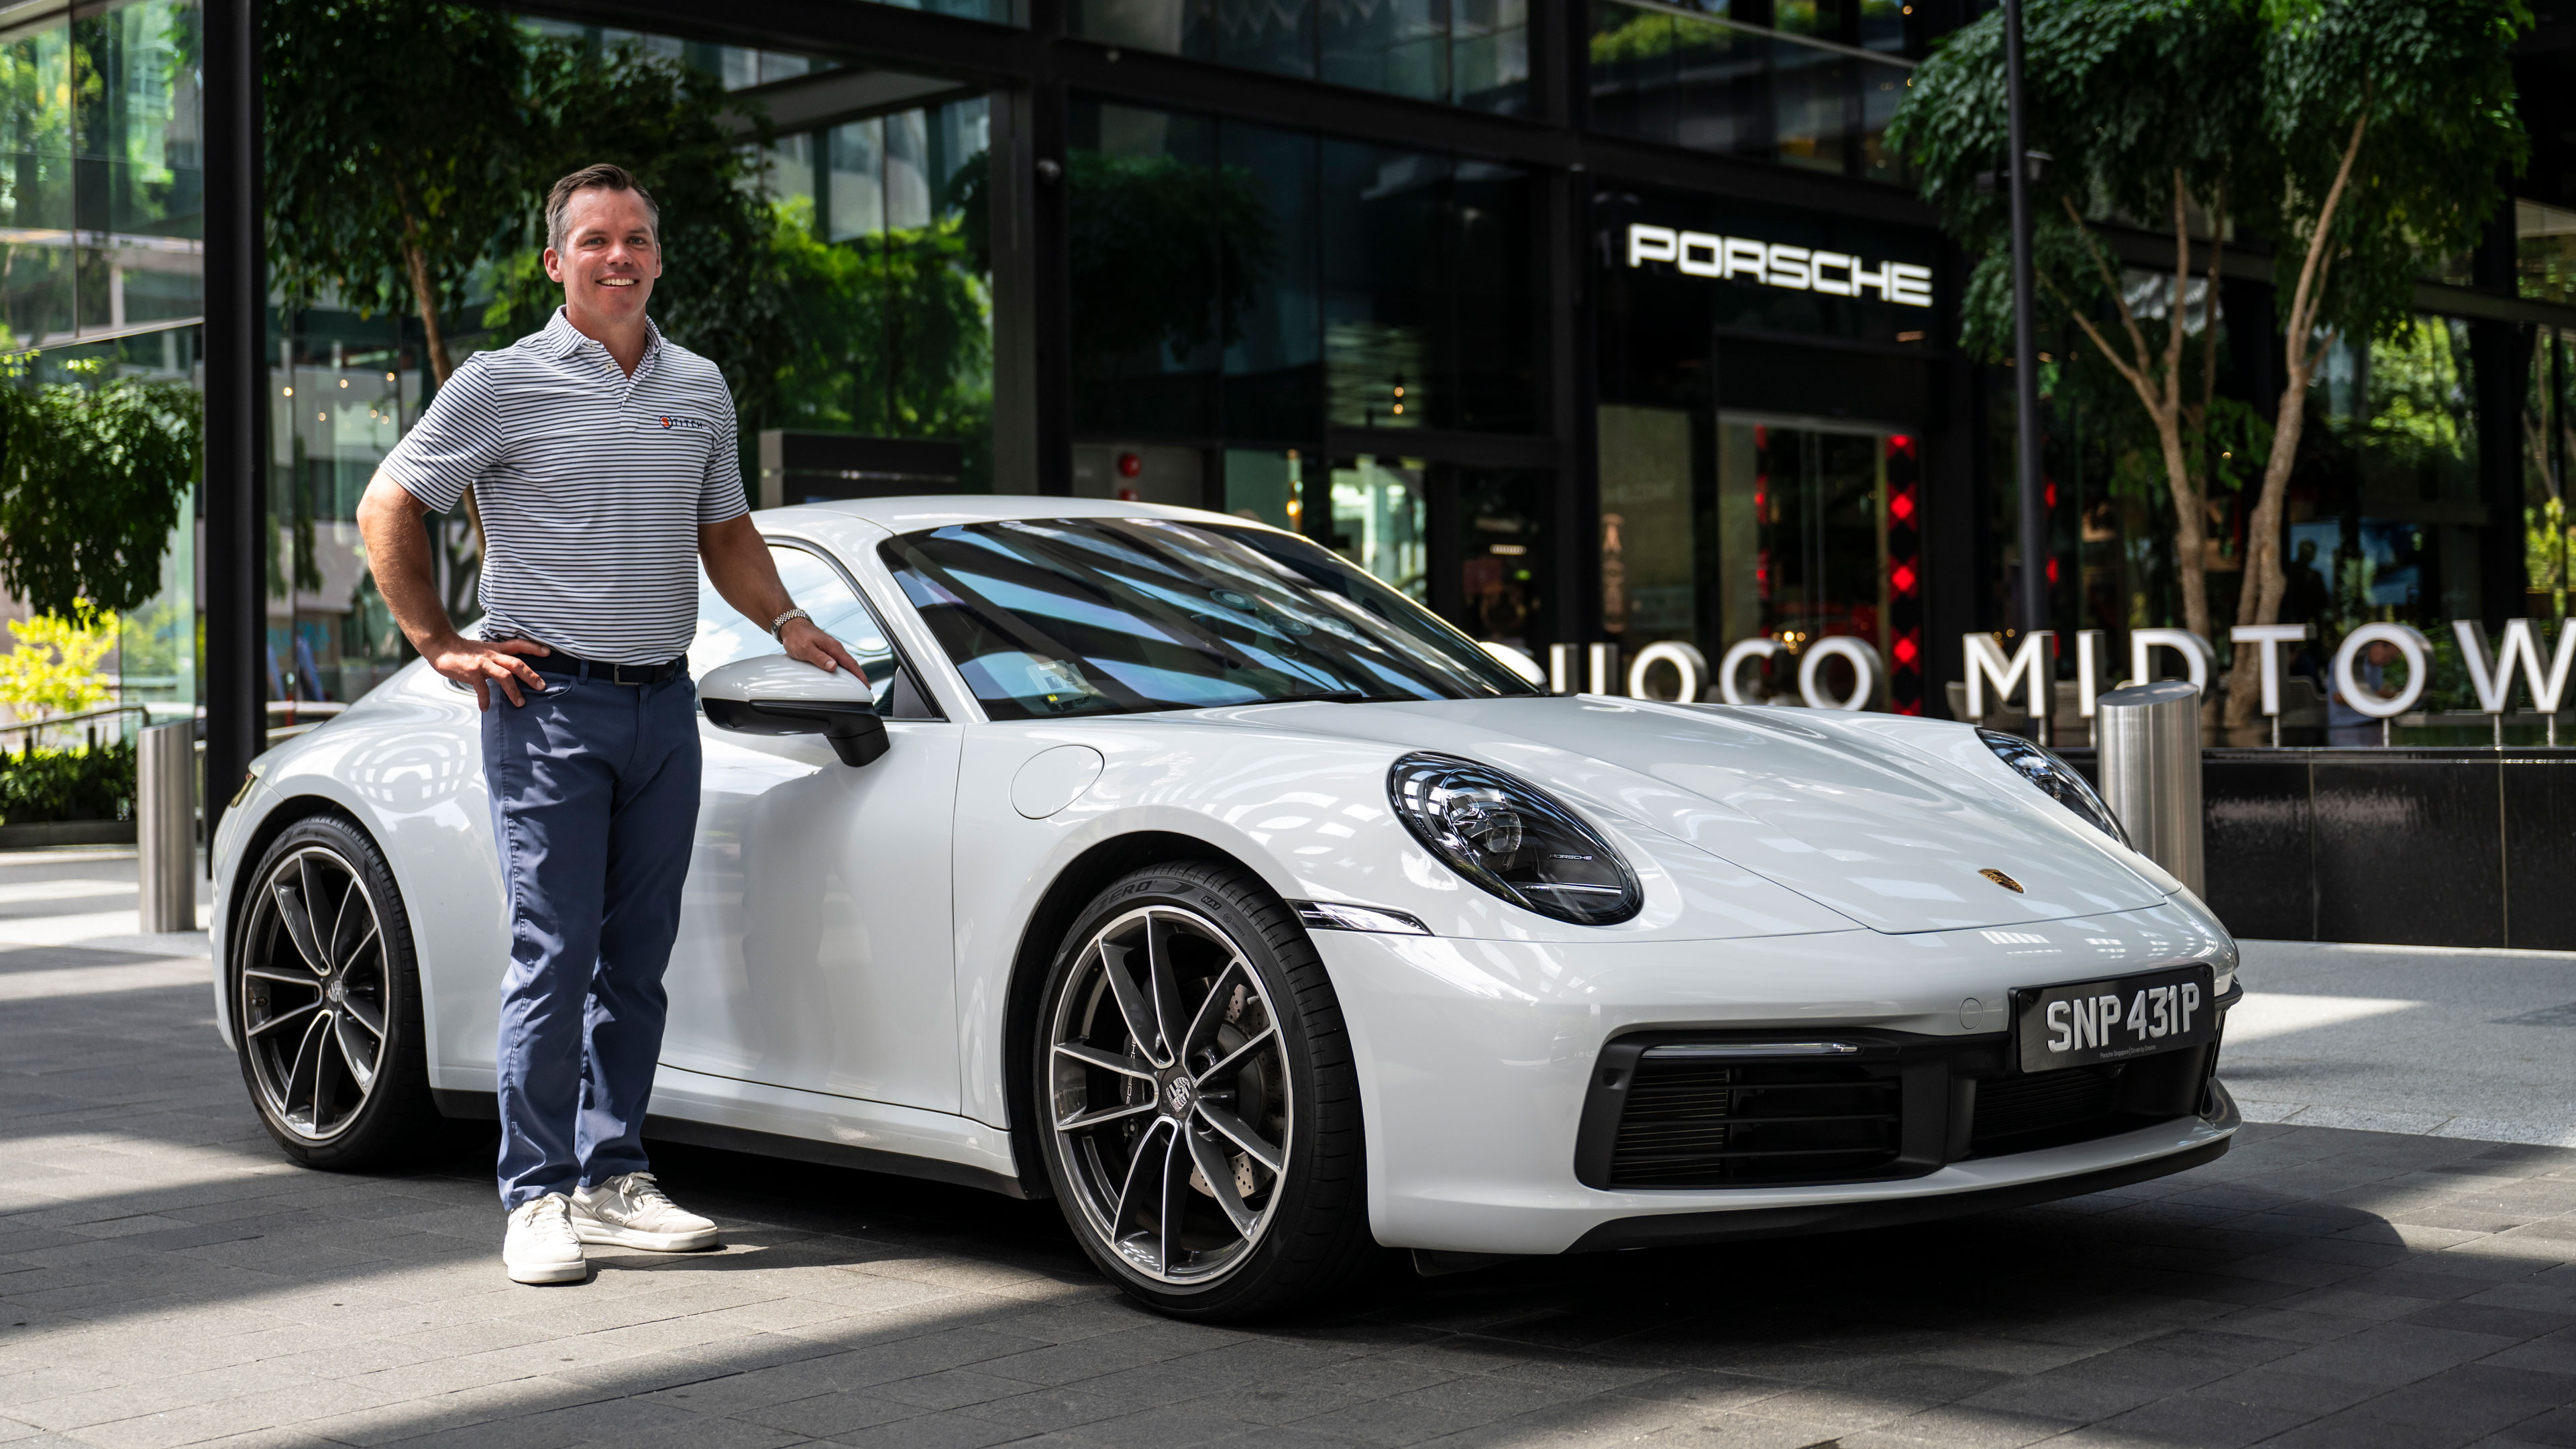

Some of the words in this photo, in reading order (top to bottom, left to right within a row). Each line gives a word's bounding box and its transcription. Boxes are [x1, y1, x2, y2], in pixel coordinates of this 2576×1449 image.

[1627, 223, 1933, 307] PORSCHE
[659, 416, 703, 429] STITCH
[1550, 635, 1876, 712] UOCO
[1095, 880, 1152, 913] ZERO
[2047, 995, 2121, 1053] SNP
[2127, 982, 2200, 1040] 431P
[2113, 1049, 2129, 1057] Singapore
